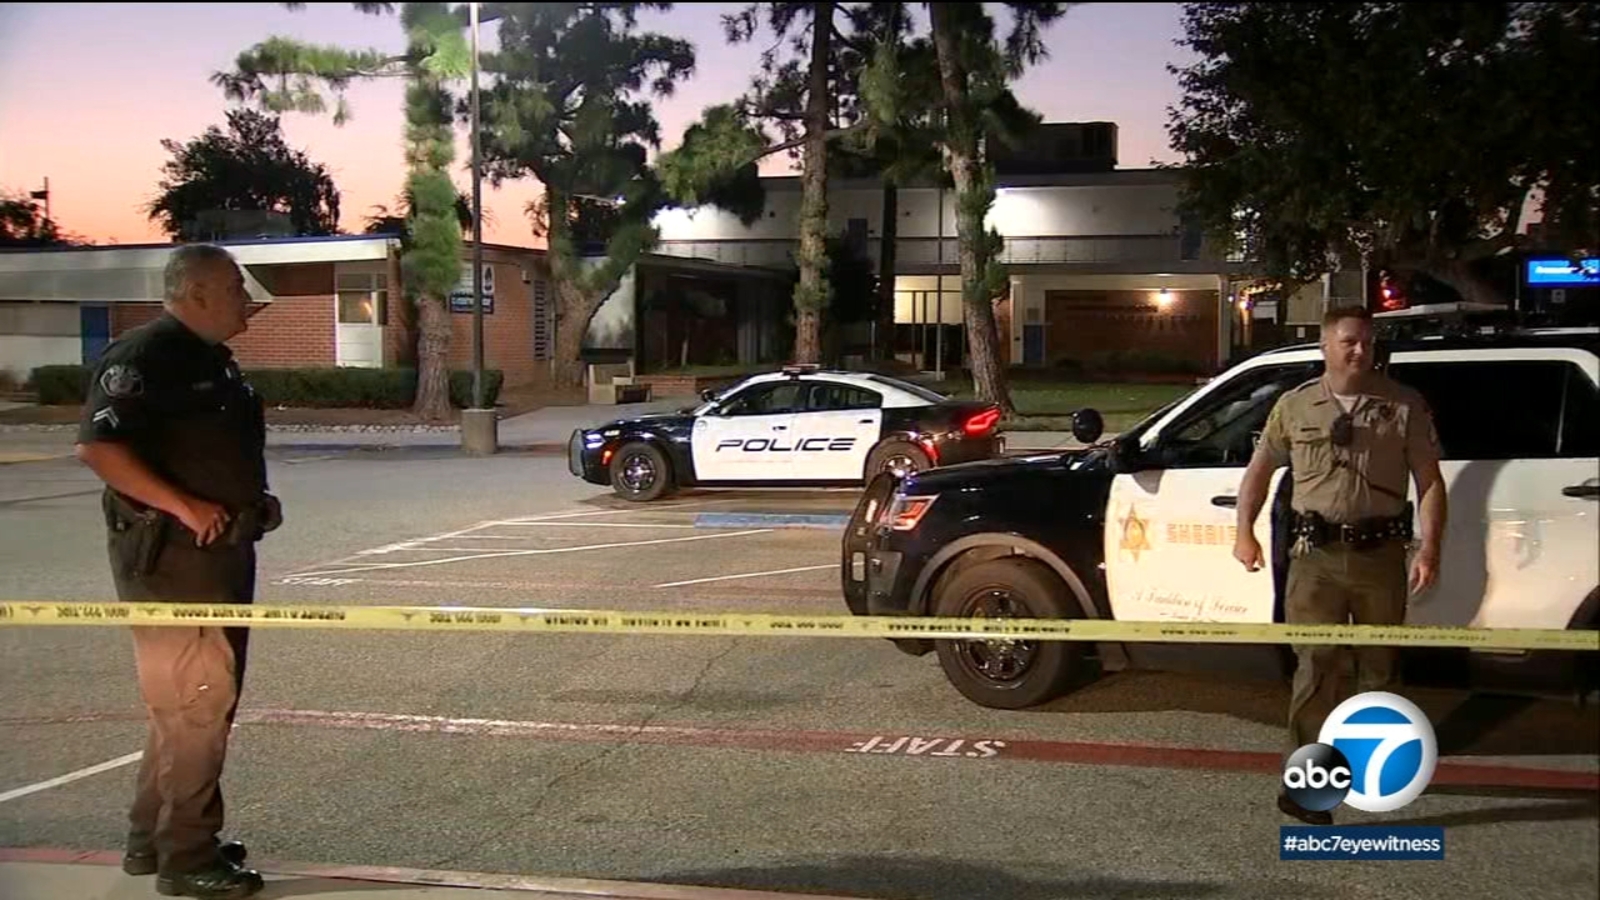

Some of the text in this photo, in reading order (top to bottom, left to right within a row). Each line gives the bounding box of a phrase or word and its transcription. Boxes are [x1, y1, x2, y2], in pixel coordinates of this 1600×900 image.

[715, 437, 857, 452] POLICE
[1166, 523, 1238, 545] SHERIF
[844, 735, 1006, 758] STAFF
